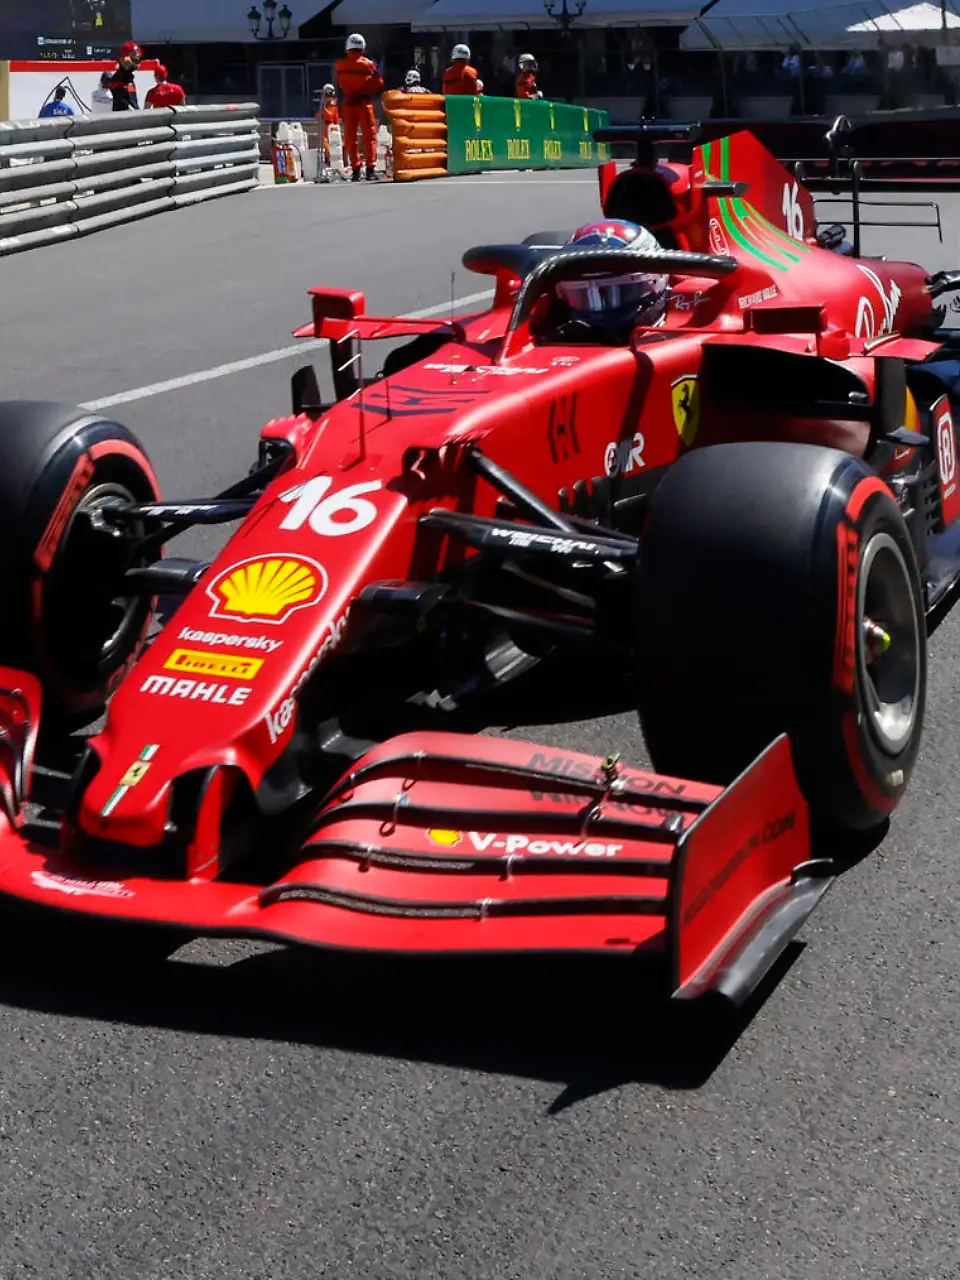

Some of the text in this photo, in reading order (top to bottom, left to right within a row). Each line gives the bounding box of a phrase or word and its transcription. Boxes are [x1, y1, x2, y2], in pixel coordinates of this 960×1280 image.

[781, 181, 804, 242] 16
[278, 475, 383, 536] 16
[177, 626, 284, 653] kaspersky
[140, 675, 253, 706] MAHLE
[467, 831, 624, 857] V-Power
